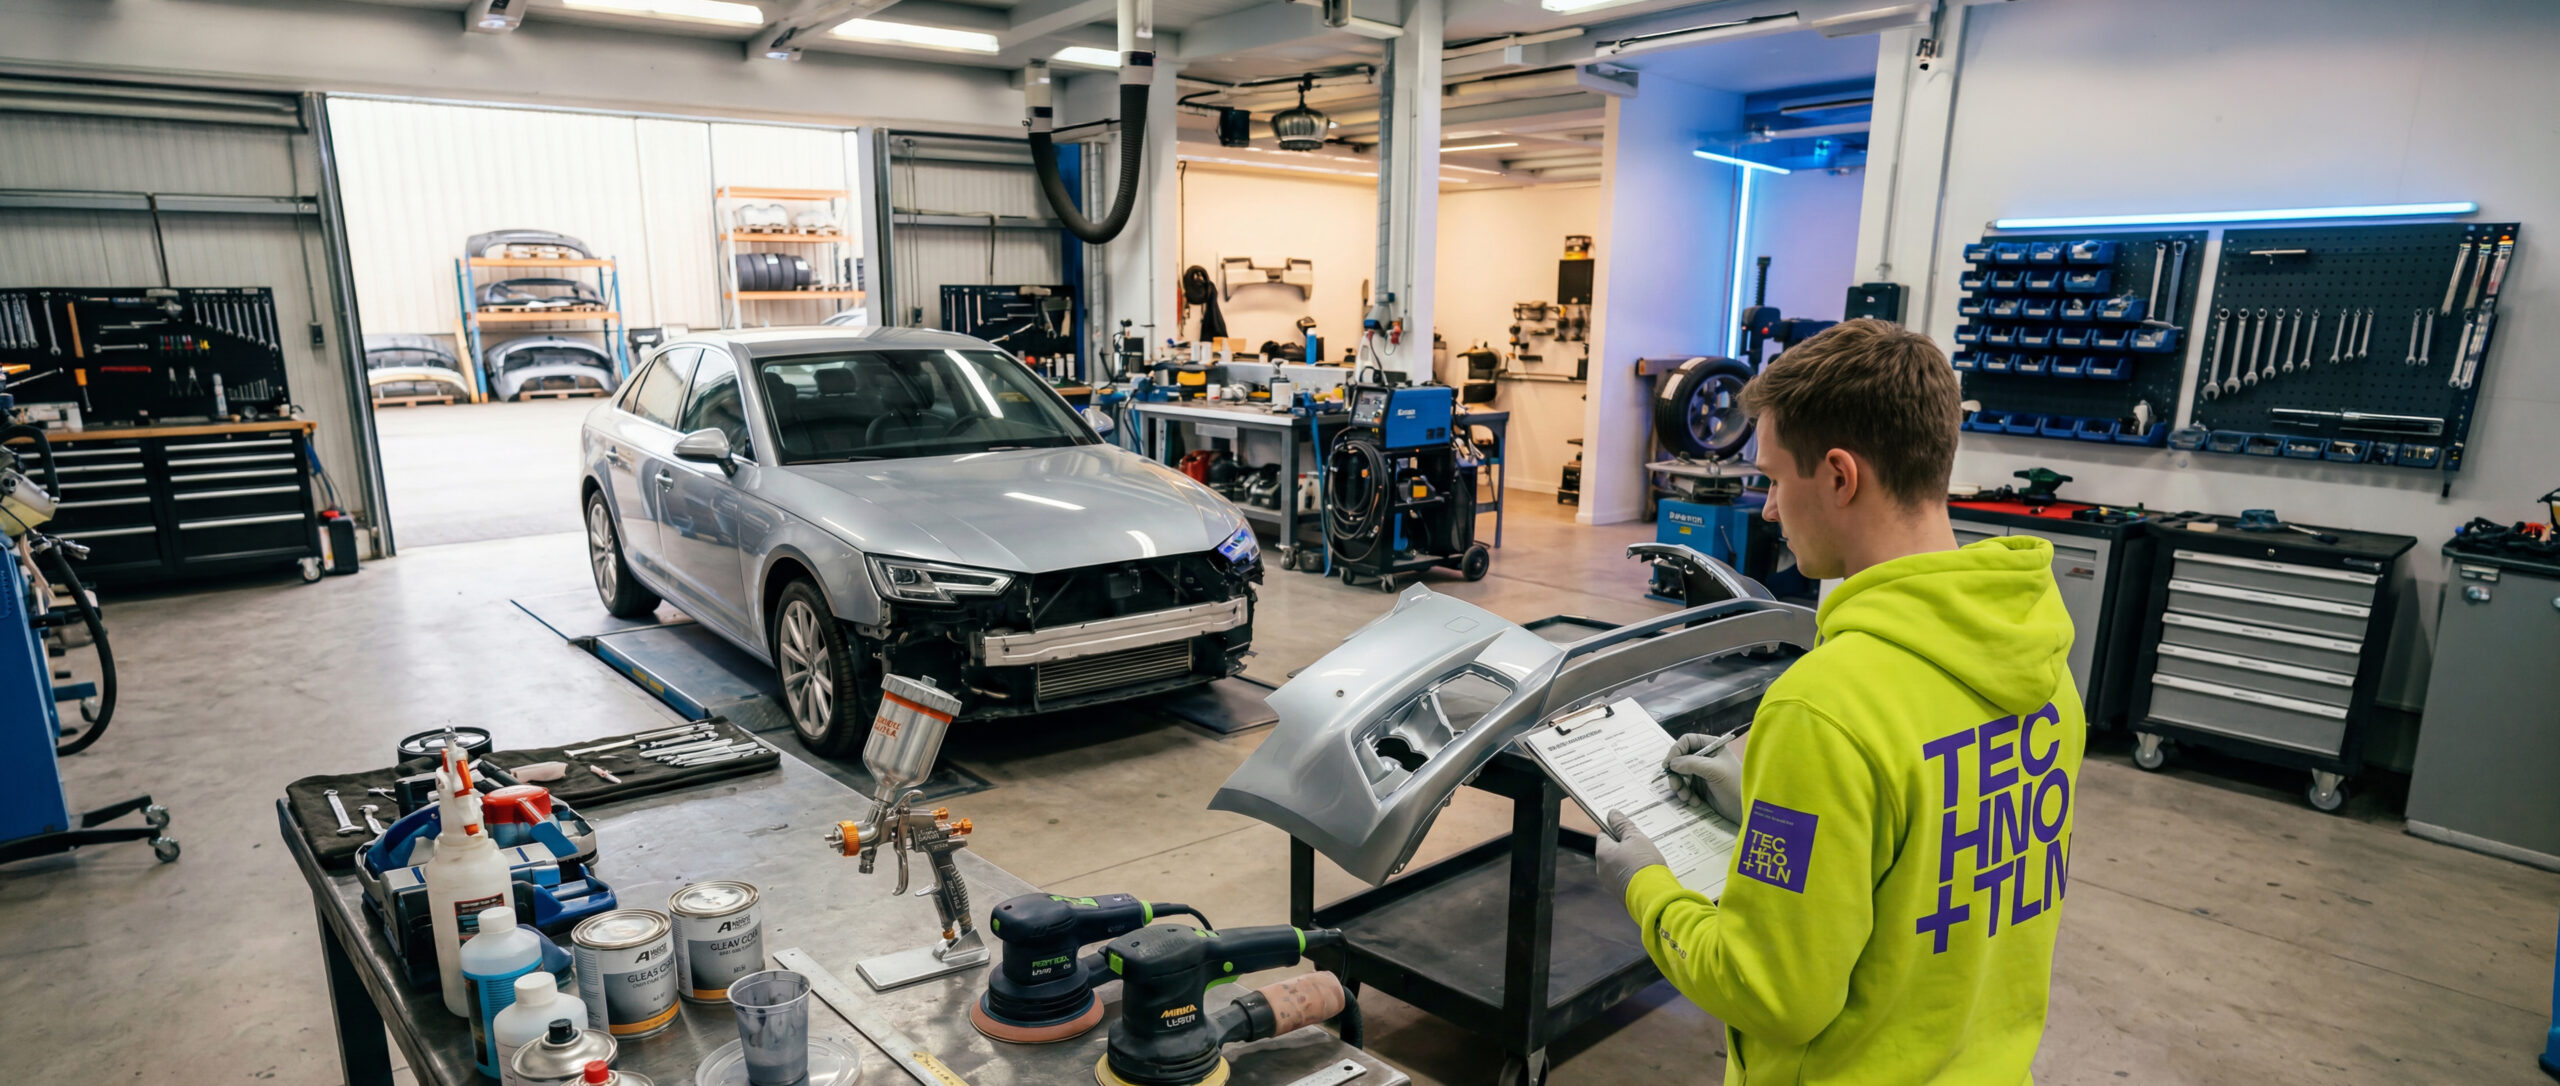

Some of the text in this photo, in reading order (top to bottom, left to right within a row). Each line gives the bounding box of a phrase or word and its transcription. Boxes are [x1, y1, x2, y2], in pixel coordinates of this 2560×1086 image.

[1922, 701, 2060, 810] TEC
[1751, 829, 1786, 853] TEC
[1939, 768, 2070, 884] HNO
[1916, 832, 2072, 955] +TLN
